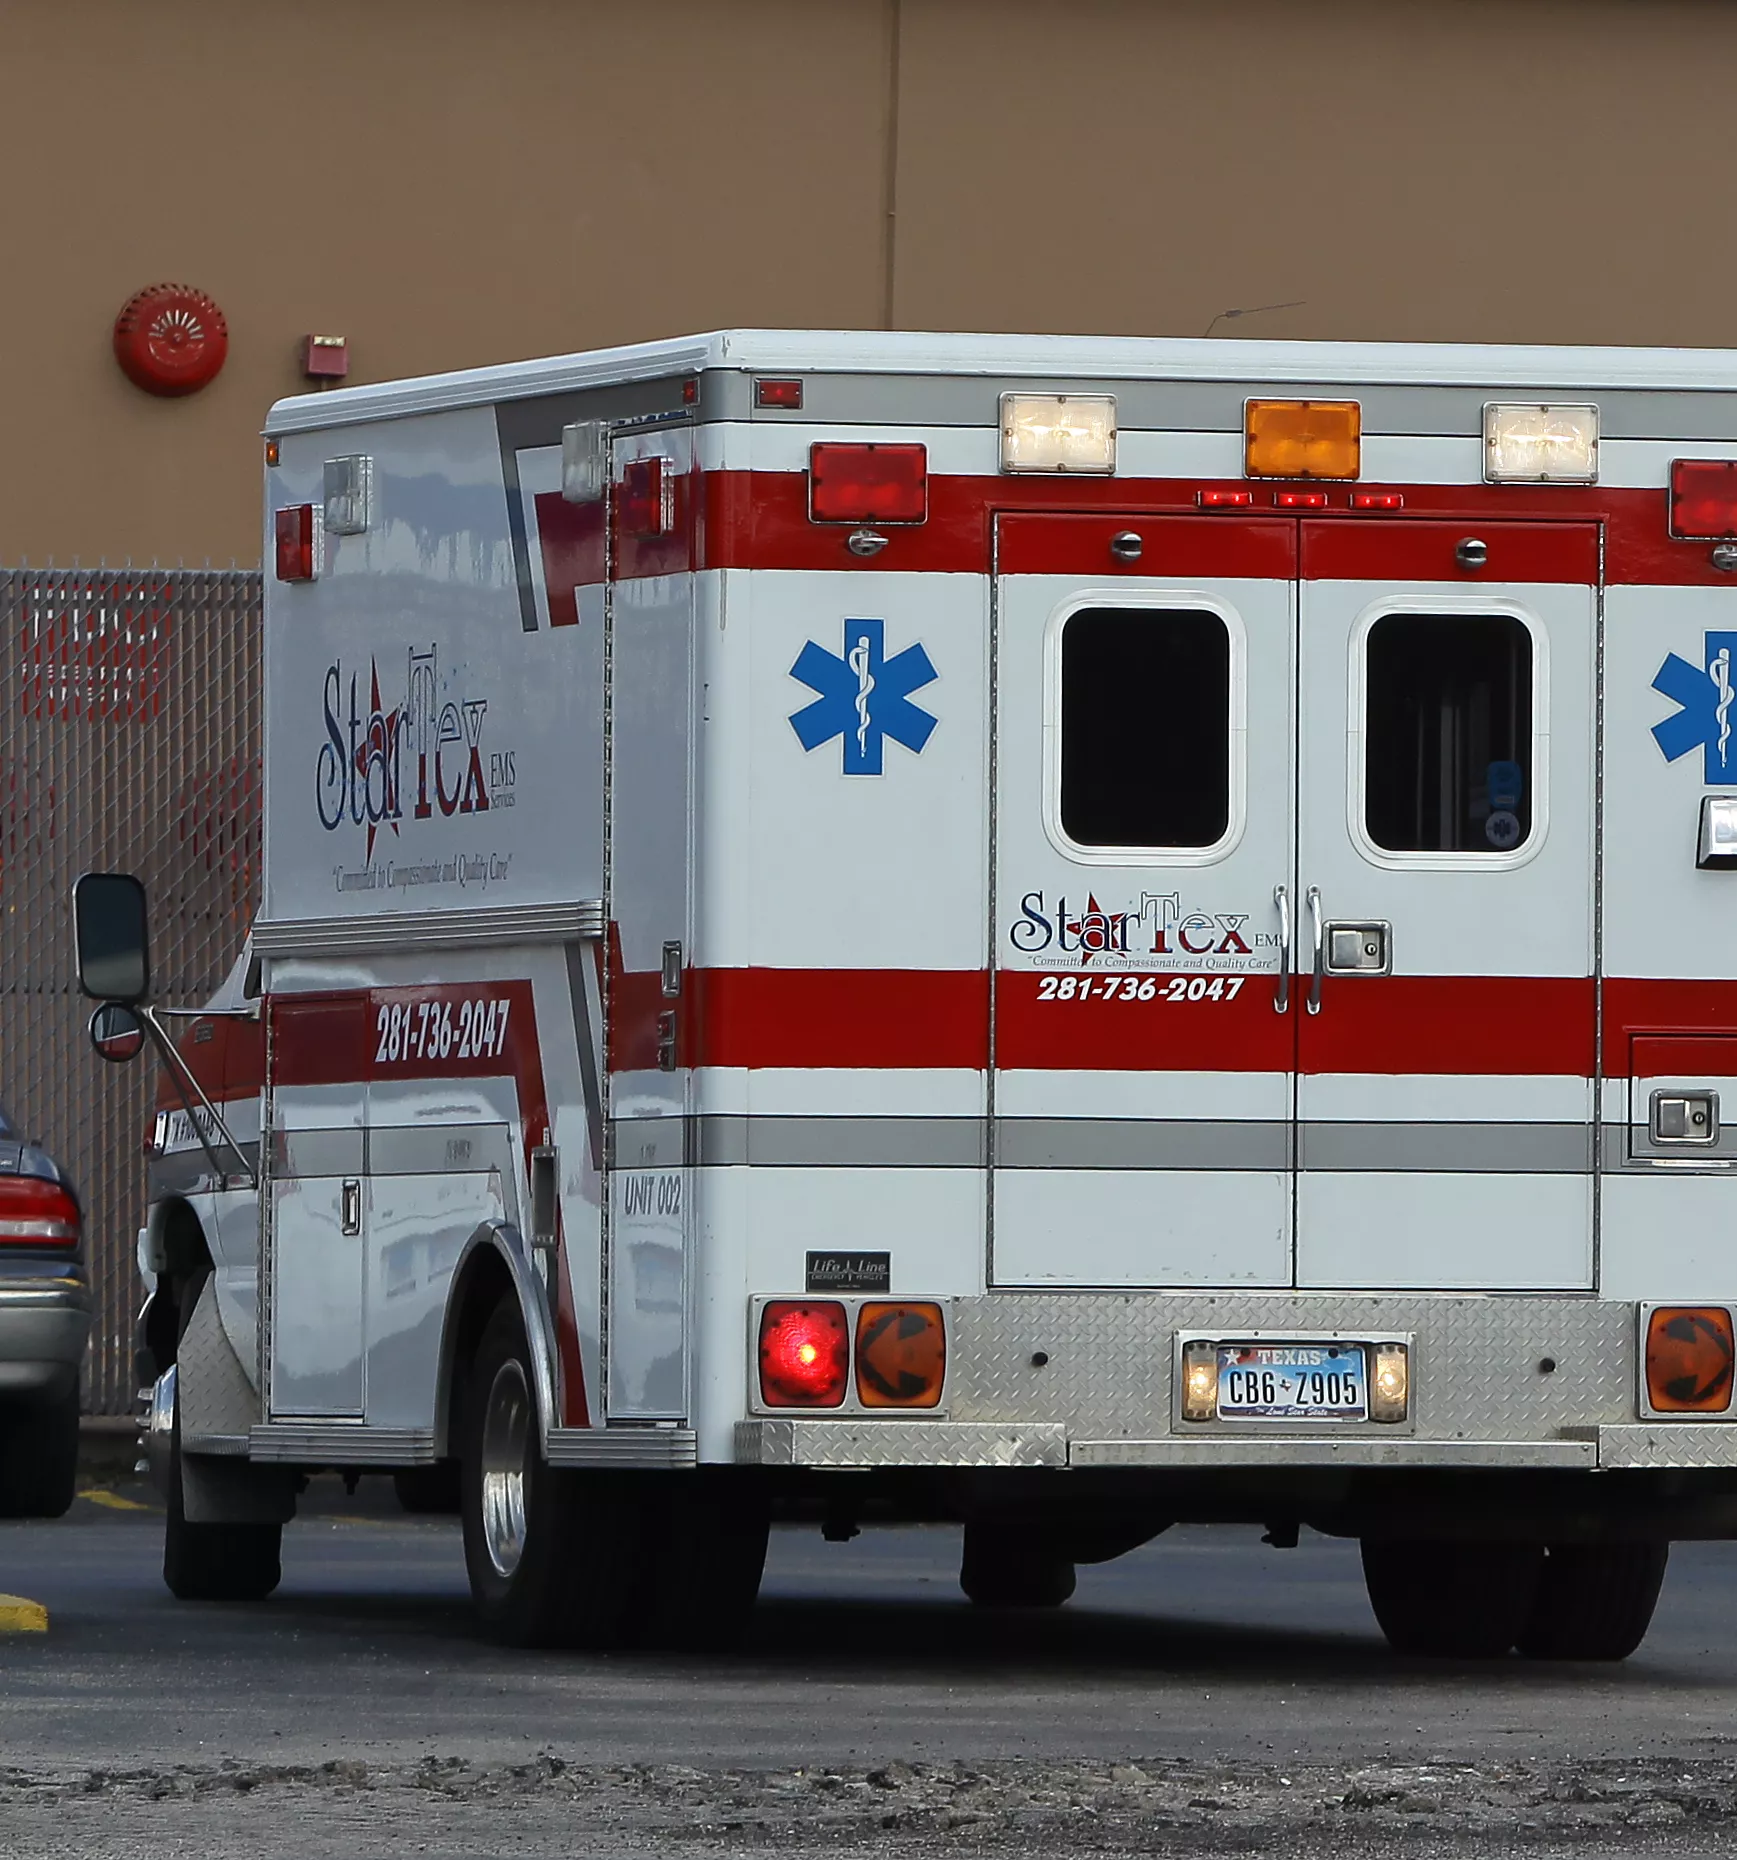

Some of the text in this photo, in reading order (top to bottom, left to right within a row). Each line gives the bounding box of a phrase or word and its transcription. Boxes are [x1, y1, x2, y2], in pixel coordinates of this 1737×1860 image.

[316, 643, 516, 830] StarTex EMS
[1010, 890, 1253, 955] StarTex
[1091, 956, 1102, 967] to
[1104, 956, 1180, 970] Compassionate
[1183, 958, 1202, 968] and
[1206, 957, 1246, 971] Quality
[1036, 976, 1245, 1002] 281-736-2047
[375, 999, 511, 1063] 281-736-2047
[625, 1175, 681, 1215] UNIT 002
[813, 1259, 886, 1272] Life Line
[1257, 1349, 1321, 1366] TEXAS
[1229, 1370, 1275, 1404] CB6
[1287, 1407, 1304, 1416] Star
[1307, 1407, 1328, 1416] State
